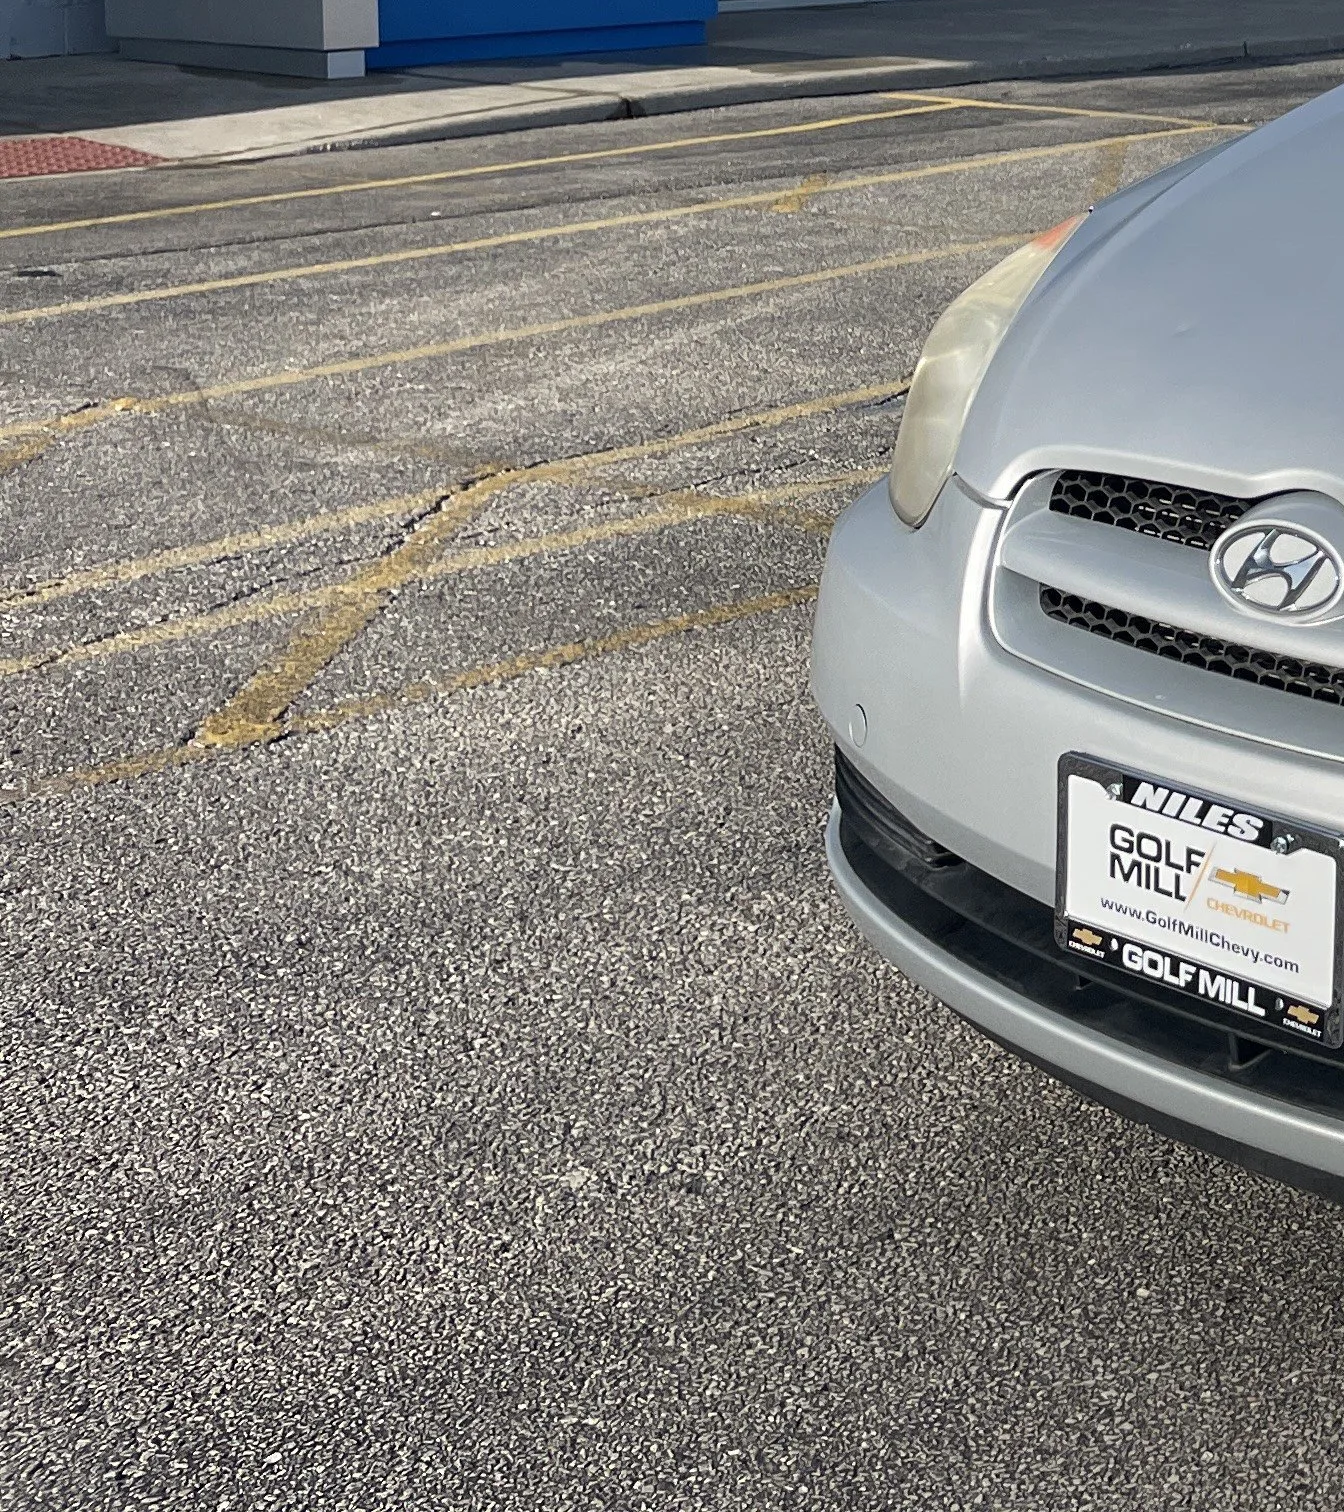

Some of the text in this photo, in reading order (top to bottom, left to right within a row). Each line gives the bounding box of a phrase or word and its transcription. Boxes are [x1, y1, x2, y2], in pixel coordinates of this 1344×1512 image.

[1131, 781, 1264, 842] NILES
[1109, 824, 1206, 874] GOLF
[1109, 852, 1188, 902] MILL
[1100, 897, 1300, 974] www.GolfMillChevy.com
[1206, 897, 1292, 934] CHEVROLET
[1121, 943, 1266, 1017] GOLF MILL
